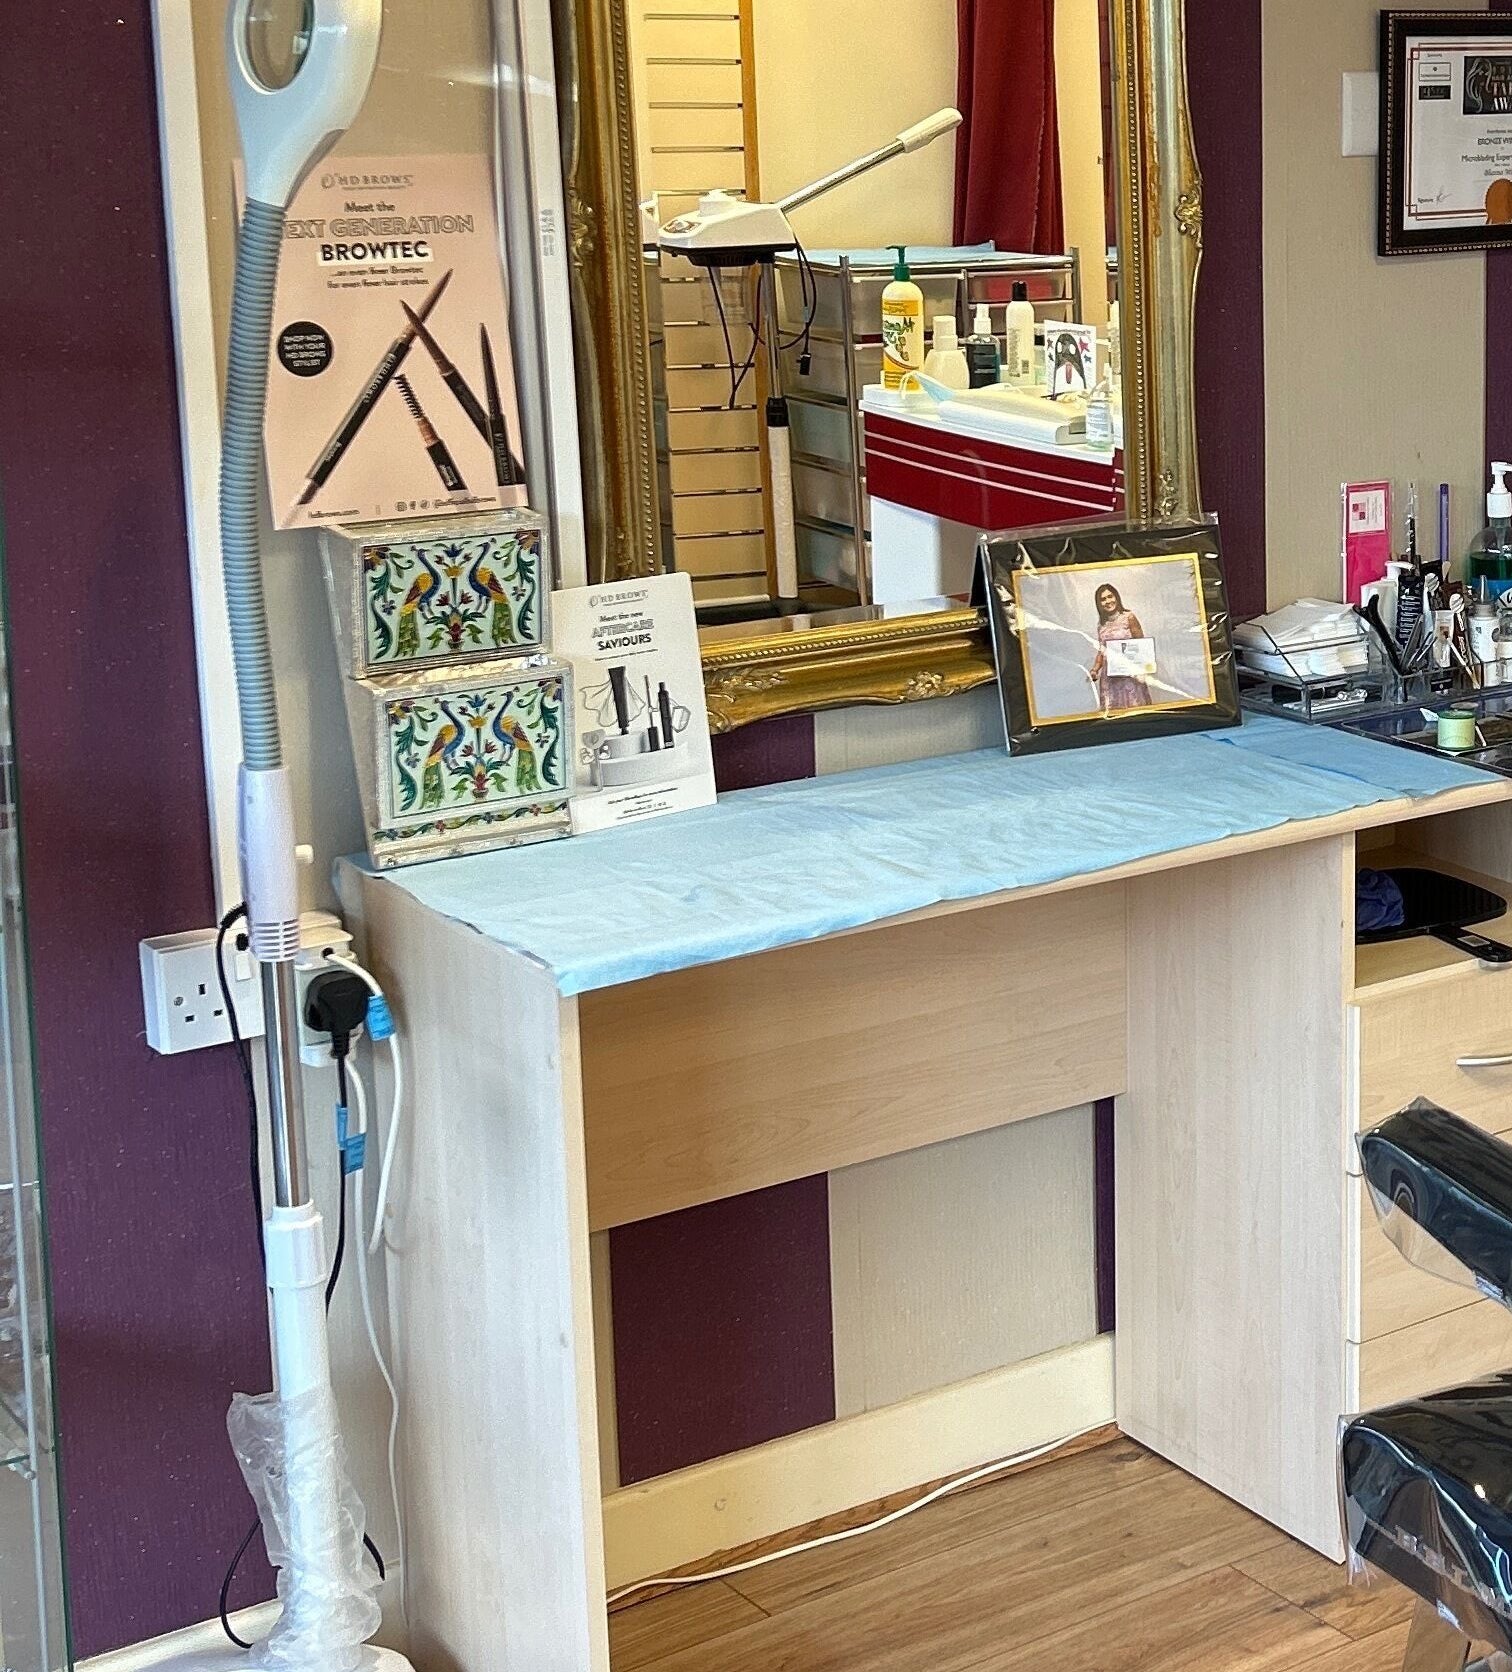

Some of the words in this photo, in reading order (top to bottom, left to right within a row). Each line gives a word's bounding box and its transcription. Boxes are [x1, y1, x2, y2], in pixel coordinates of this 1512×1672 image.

[344, 201, 374, 213] Meet
[375, 200, 396, 212] the
[284, 218, 327, 240] EXT
[328, 214, 475, 238] GENERATION
[320, 240, 430, 262] BROWTEC
[597, 632, 653, 651] SAVIOURS
